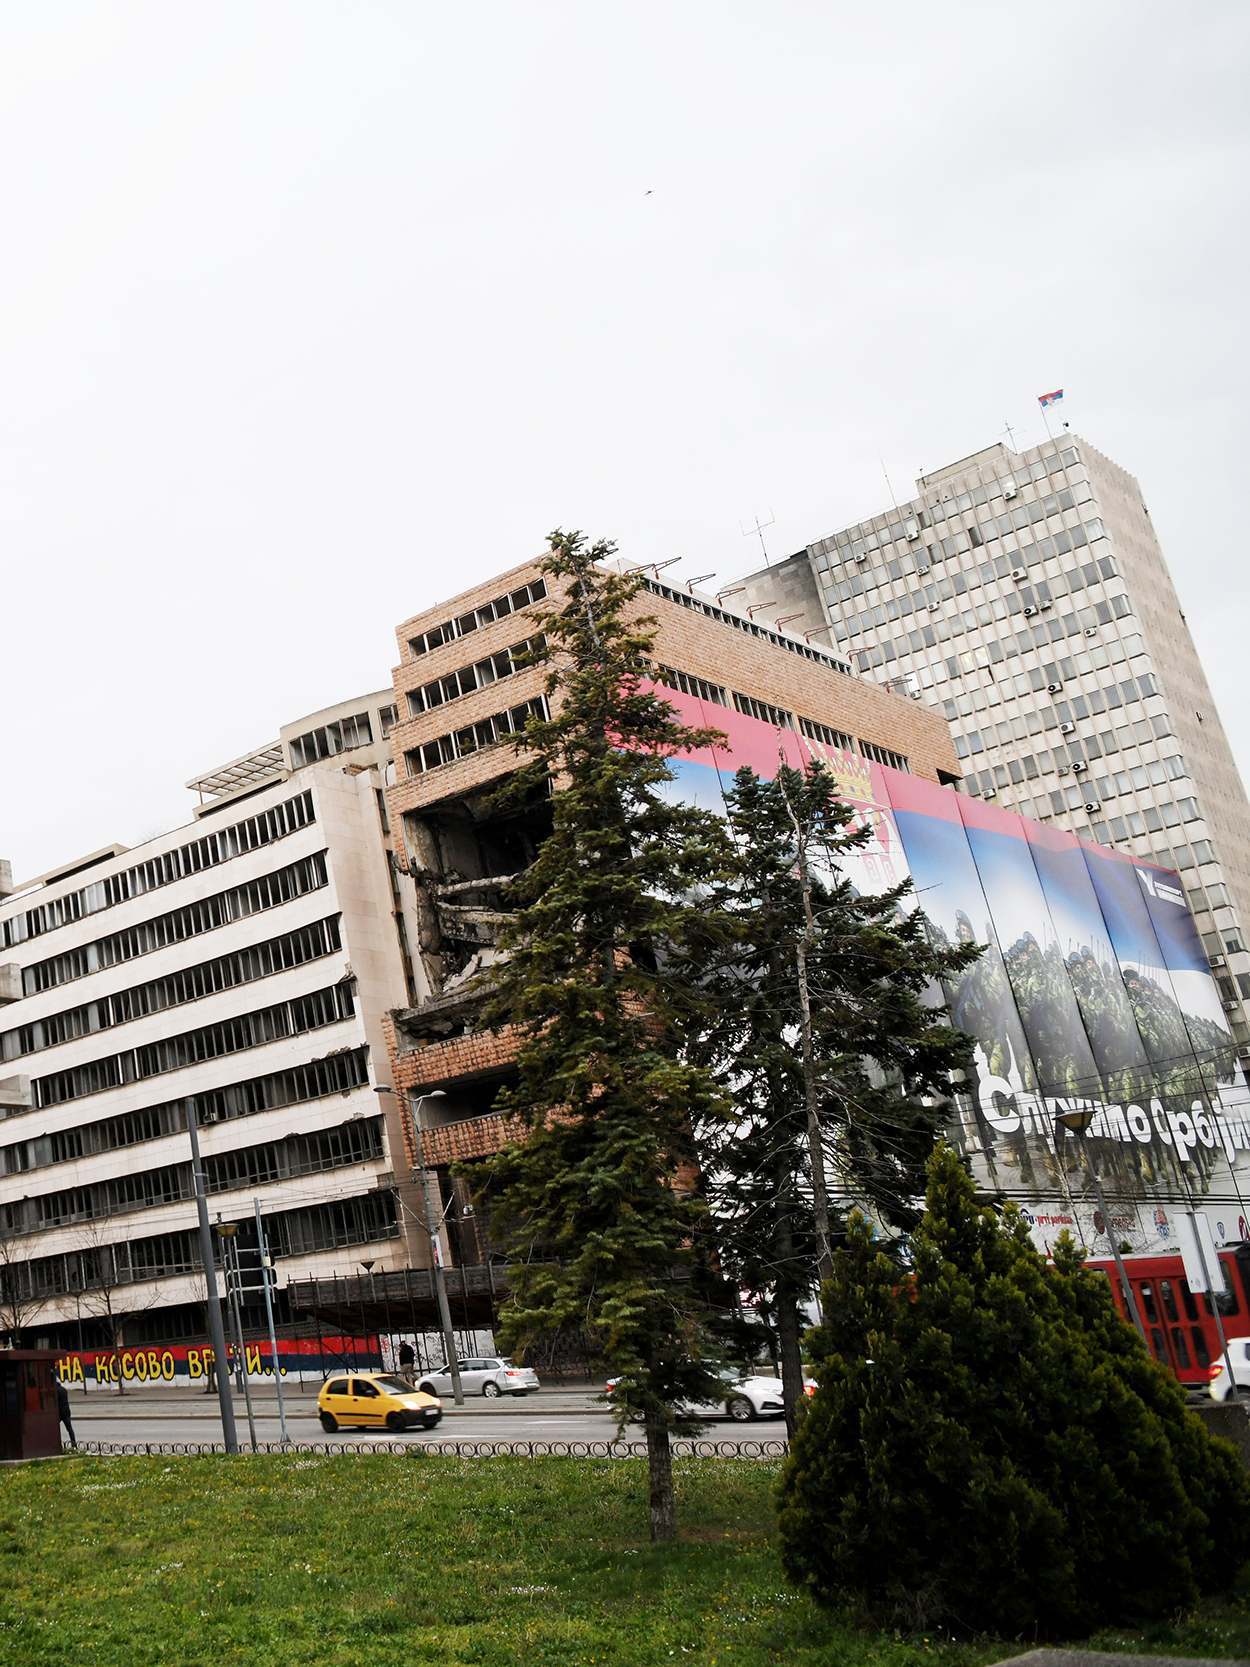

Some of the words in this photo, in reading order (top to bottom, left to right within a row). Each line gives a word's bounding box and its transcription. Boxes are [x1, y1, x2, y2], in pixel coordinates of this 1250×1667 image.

[58, 1355, 85, 1383] НА
[94, 1350, 176, 1384] КОСОВО
[187, 1344, 287, 1379] ВРИ...
